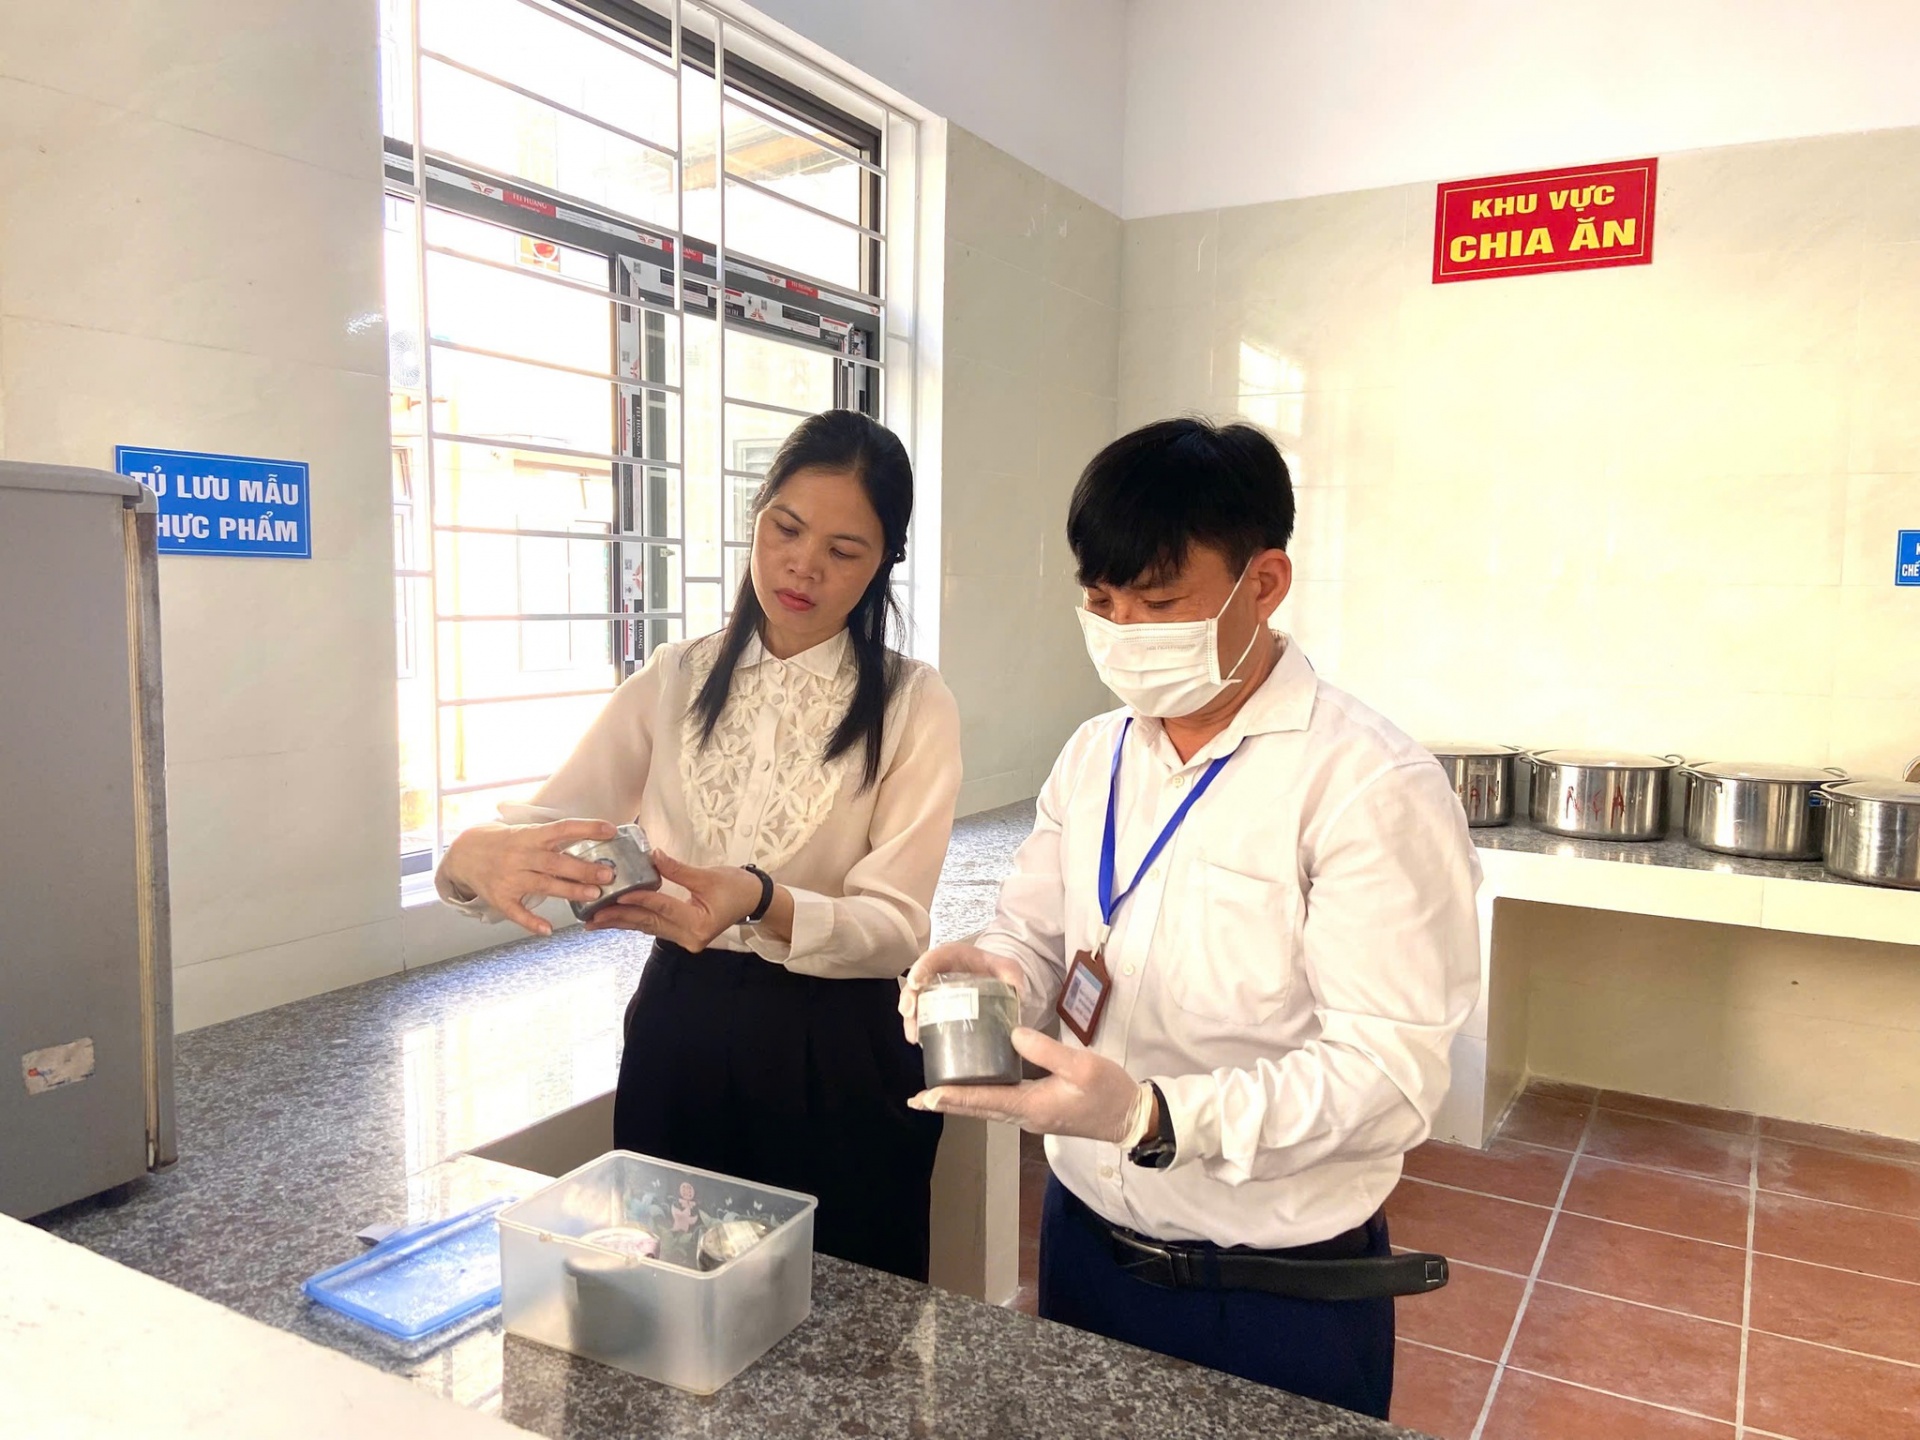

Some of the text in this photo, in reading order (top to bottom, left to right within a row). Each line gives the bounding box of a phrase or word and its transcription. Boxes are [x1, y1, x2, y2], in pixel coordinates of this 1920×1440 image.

[1471, 185, 1615, 219] KHU VỰC
[1450, 216, 1636, 263] CHIA ĂN
[130, 465, 299, 506] TỦ LƯU MẪU
[157, 511, 298, 543] HỰC PHẨM
